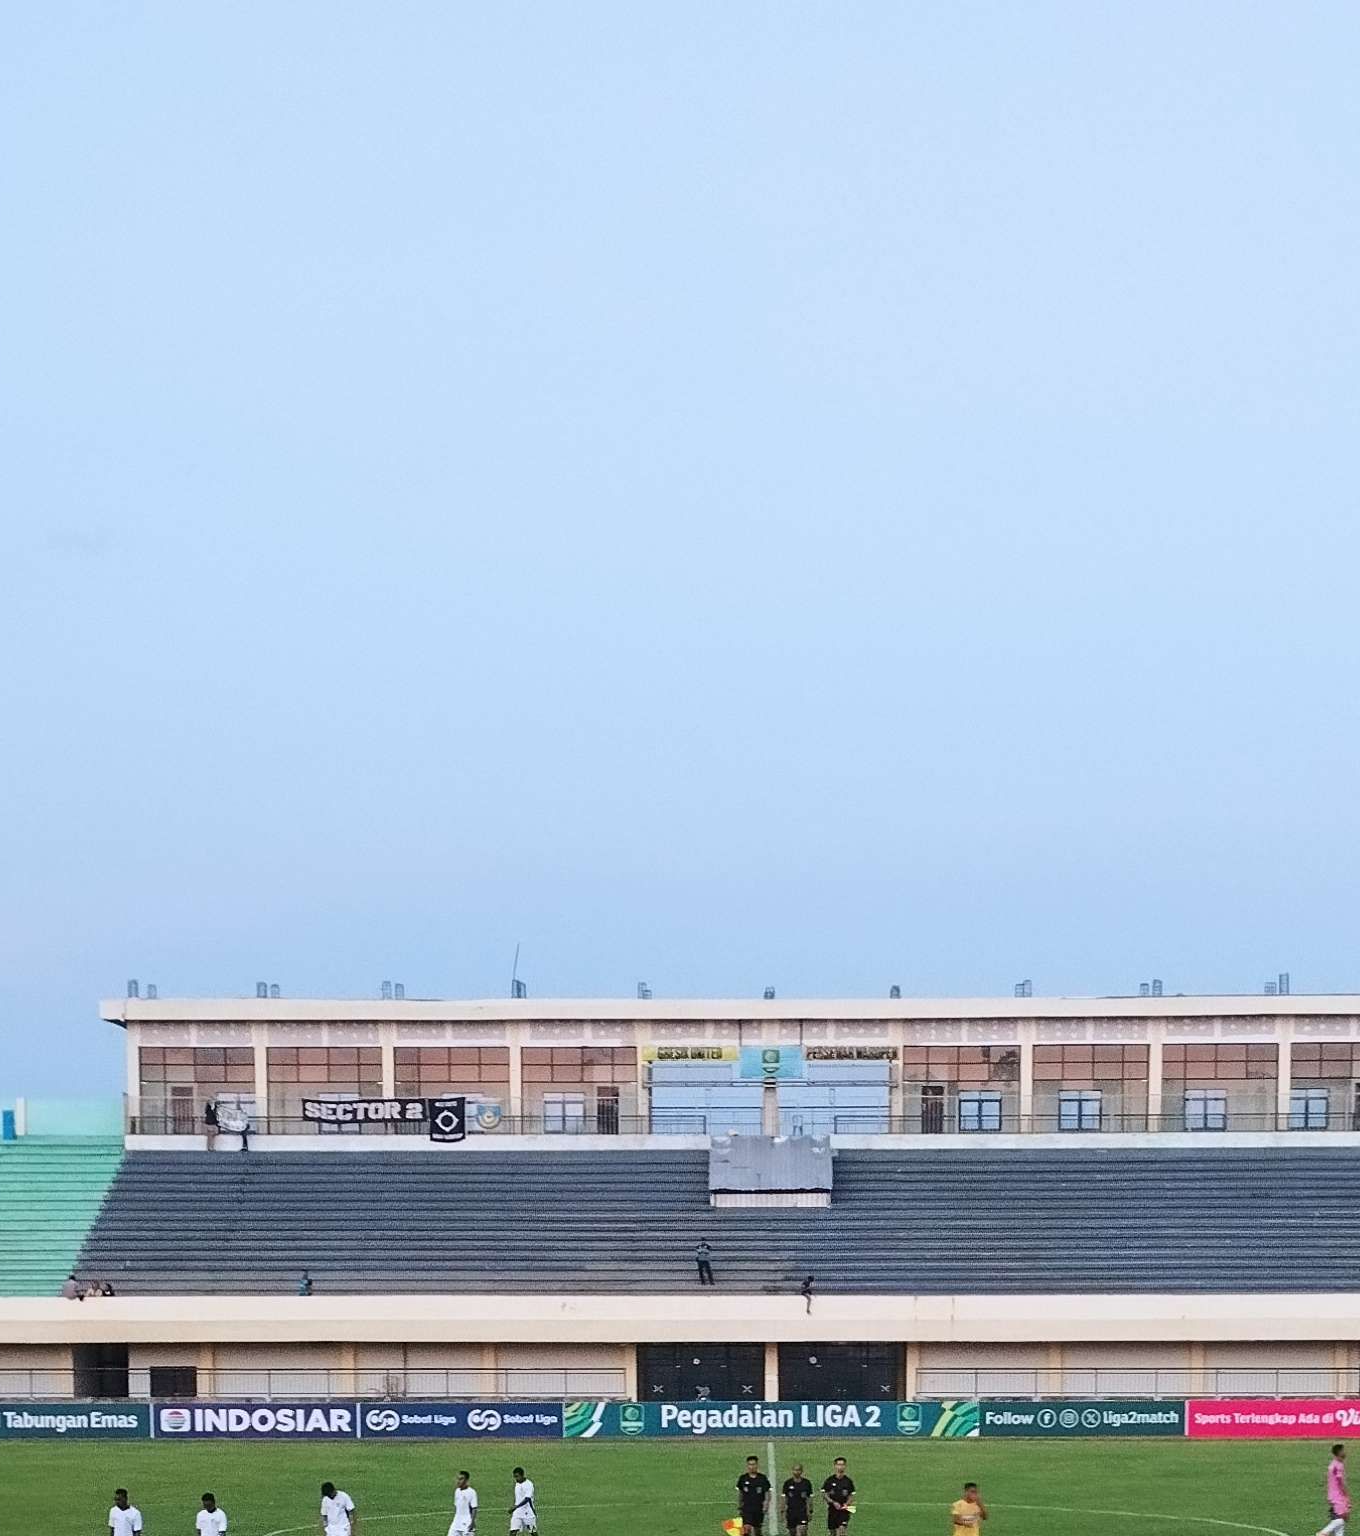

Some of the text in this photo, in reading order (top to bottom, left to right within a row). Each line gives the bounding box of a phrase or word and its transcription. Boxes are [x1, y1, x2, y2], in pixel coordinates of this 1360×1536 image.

[305, 1101, 423, 1121] SECTOR 2
[2, 1411, 89, 1432] Tabungan
[90, 1411, 138, 1429] Emas
[194, 1408, 352, 1433] INDOSIAR
[434, 1413, 457, 1425] Liga
[535, 1413, 558, 1425] Liga
[660, 1404, 881, 1434] Pegadaian LIGA 2
[985, 1411, 1035, 1425] Follow
[1194, 1413, 1232, 1426] Sports
[1297, 1412, 1320, 1424] Ada
[1321, 1412, 1334, 1424] di
